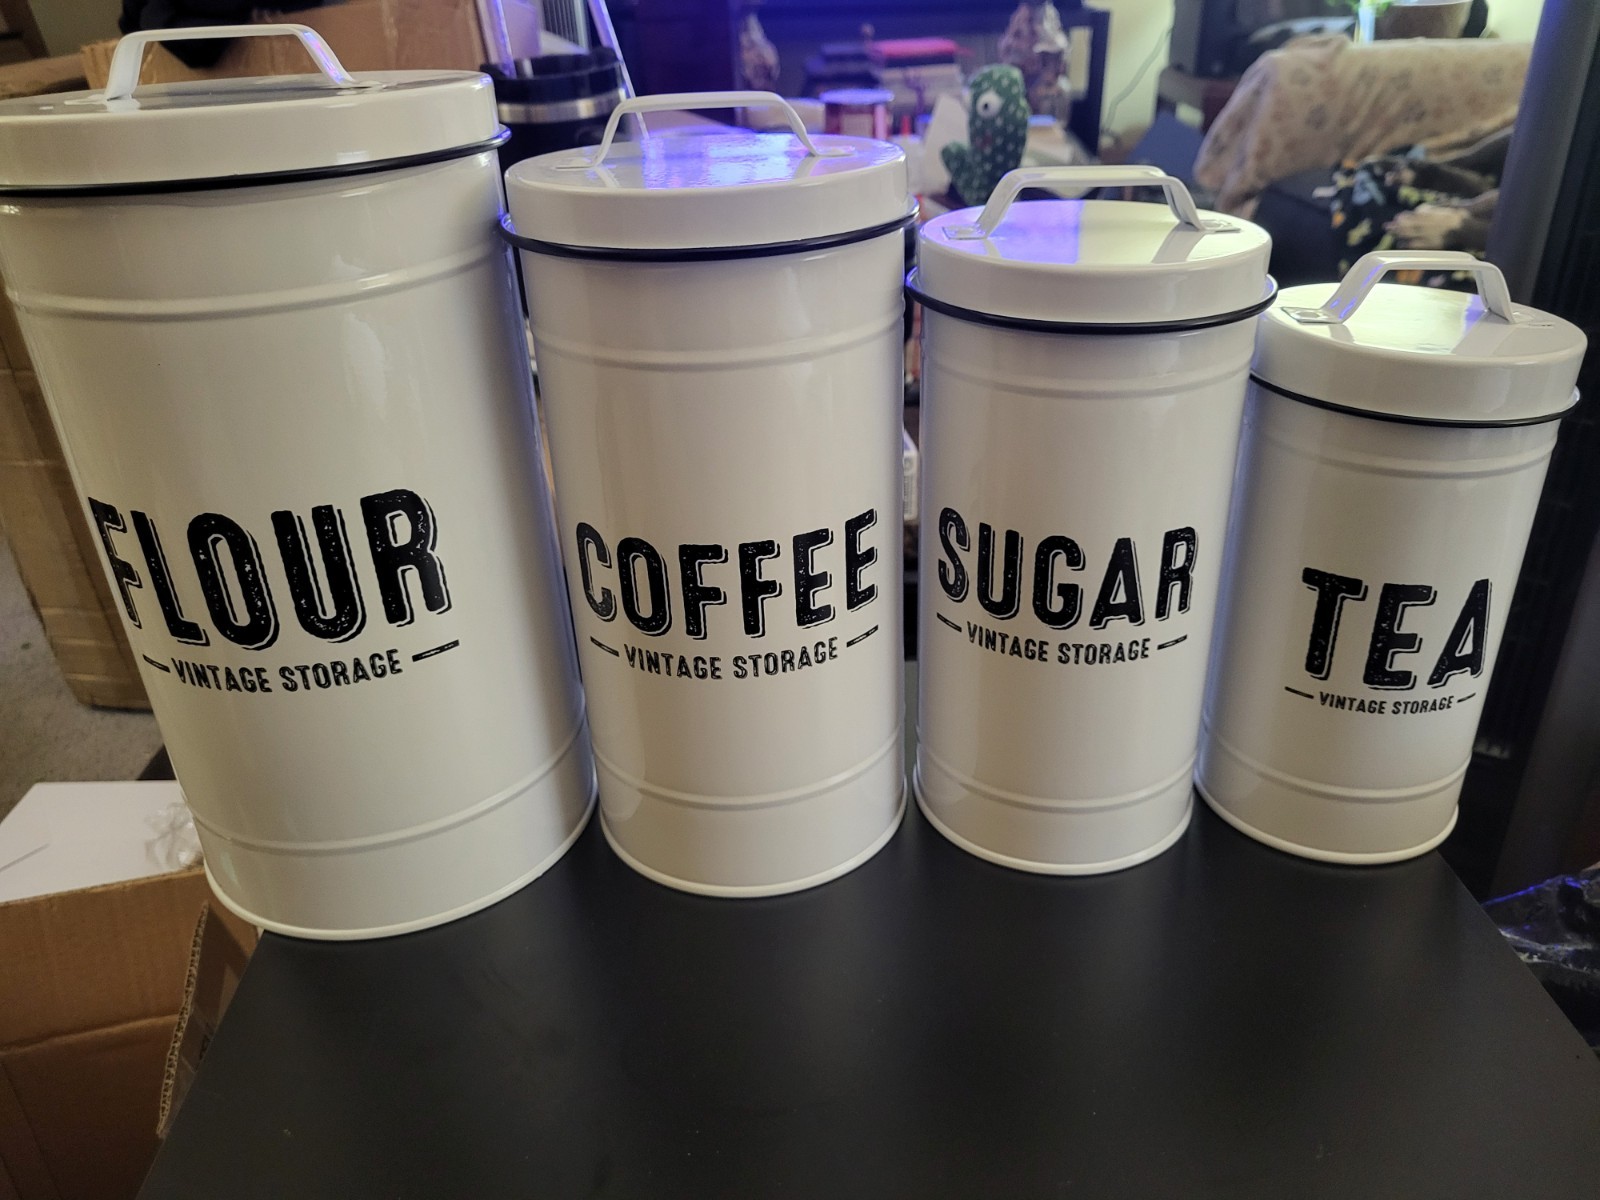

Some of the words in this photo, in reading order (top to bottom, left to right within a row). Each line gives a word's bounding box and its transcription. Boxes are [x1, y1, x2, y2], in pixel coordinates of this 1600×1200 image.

[88, 489, 452, 651] FLOUR
[576, 508, 878, 640] COFFEE
[938, 507, 1198, 630] SUGAR
[624, 643, 722, 680] VINTAGE
[732, 636, 839, 680] STORAGE
[966, 621, 1050, 662] VINTAGE
[1057, 638, 1151, 665] STORAGE
[1302, 567, 1492, 690] TEA
[172, 657, 273, 694] VINTAGE
[279, 648, 404, 693] STORAGE
[1319, 691, 1386, 714] VINTAGE
[1391, 696, 1455, 714] STORAGE
